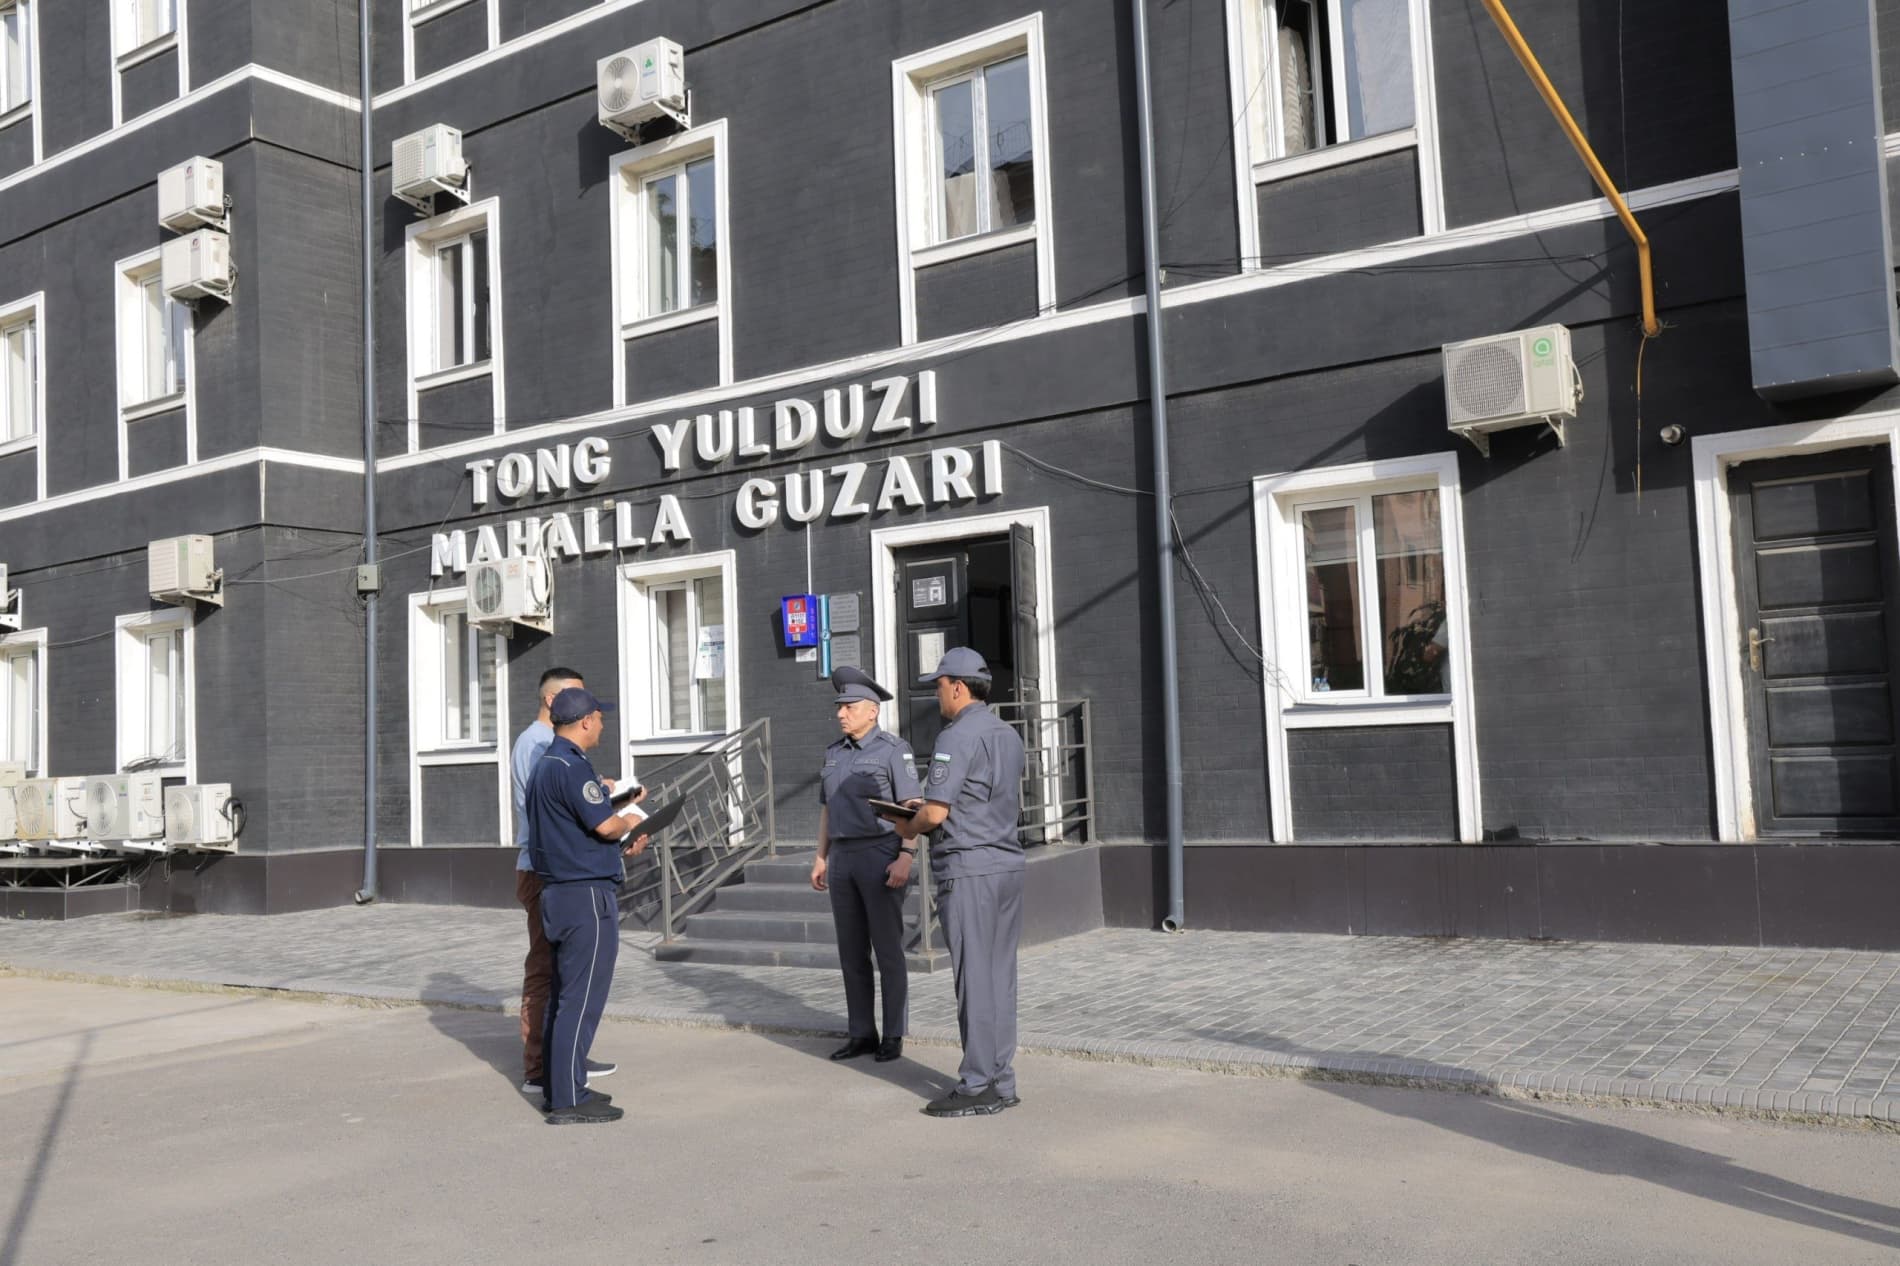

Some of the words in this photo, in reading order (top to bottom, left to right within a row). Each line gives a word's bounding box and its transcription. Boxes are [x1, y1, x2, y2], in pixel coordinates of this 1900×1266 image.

[465, 437, 611, 505] TONG
[651, 369, 938, 471] YULDUZI
[430, 494, 693, 577] MAHALLA
[735, 439, 1003, 530] GUZARI
